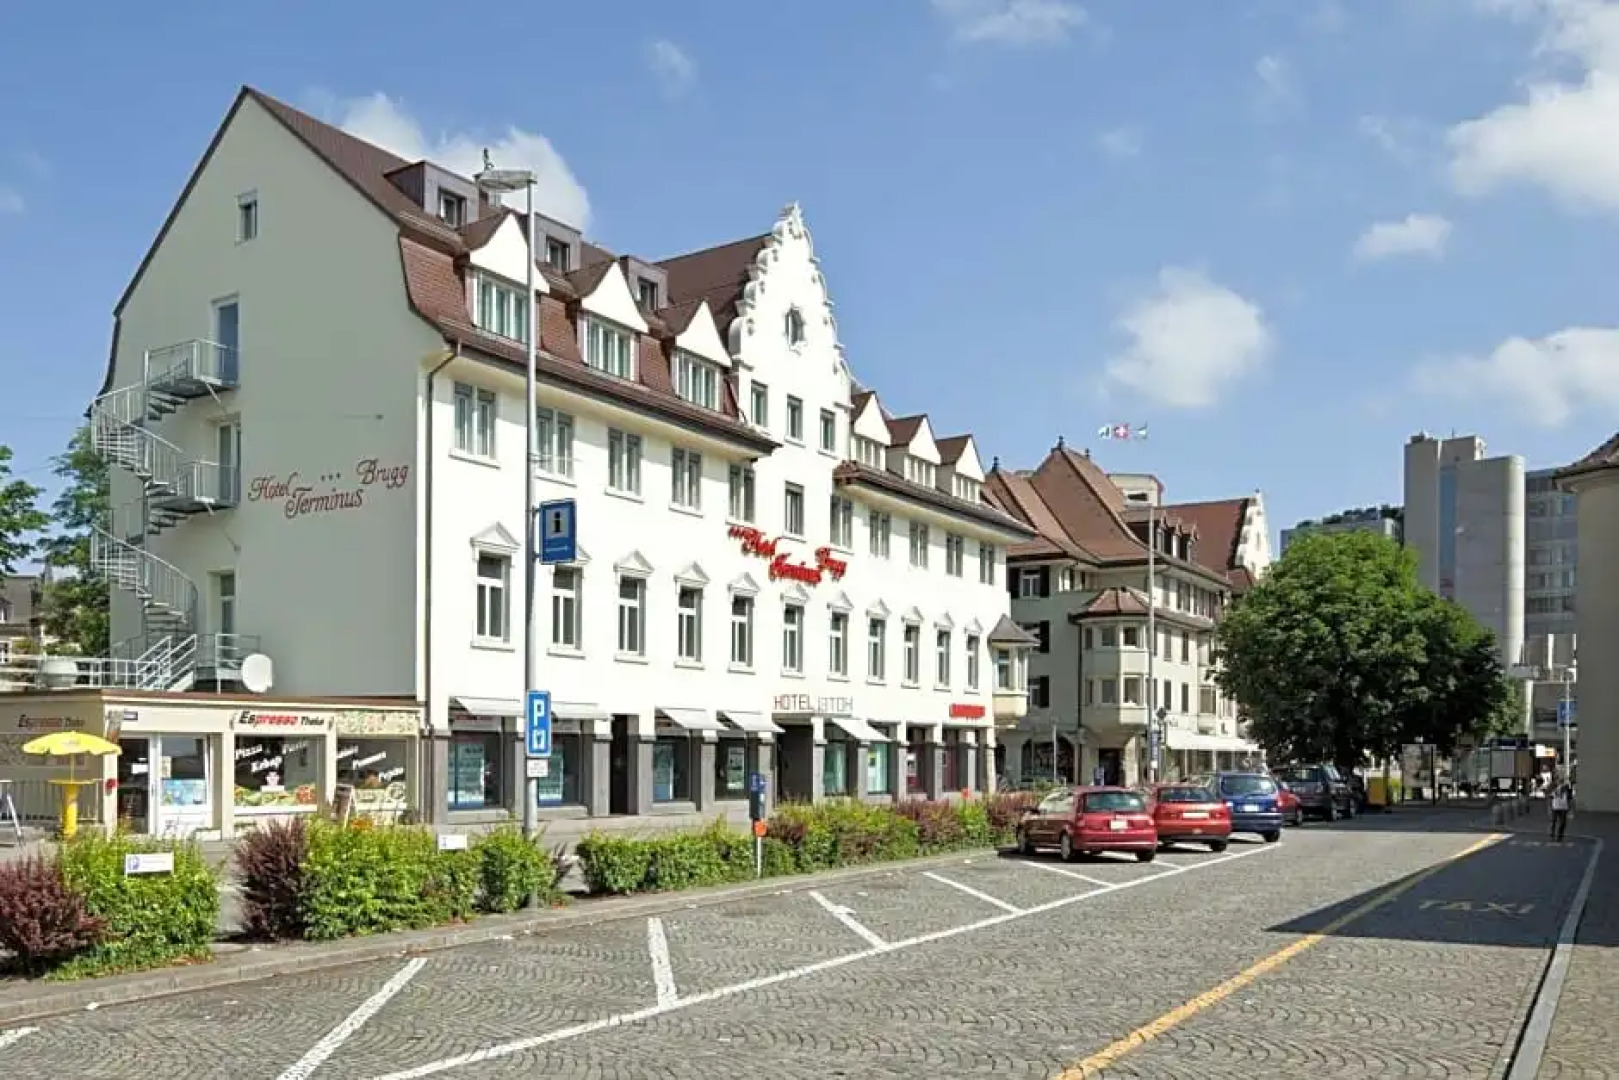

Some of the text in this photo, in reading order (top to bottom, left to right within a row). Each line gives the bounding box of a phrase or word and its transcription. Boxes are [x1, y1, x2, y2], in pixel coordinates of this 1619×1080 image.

[248, 458, 408, 519] Hotel Terminus Brugg
[533, 698, 545, 727] P
[774, 693, 814, 711] HOTEL
[239, 710, 299, 728] Espresso
